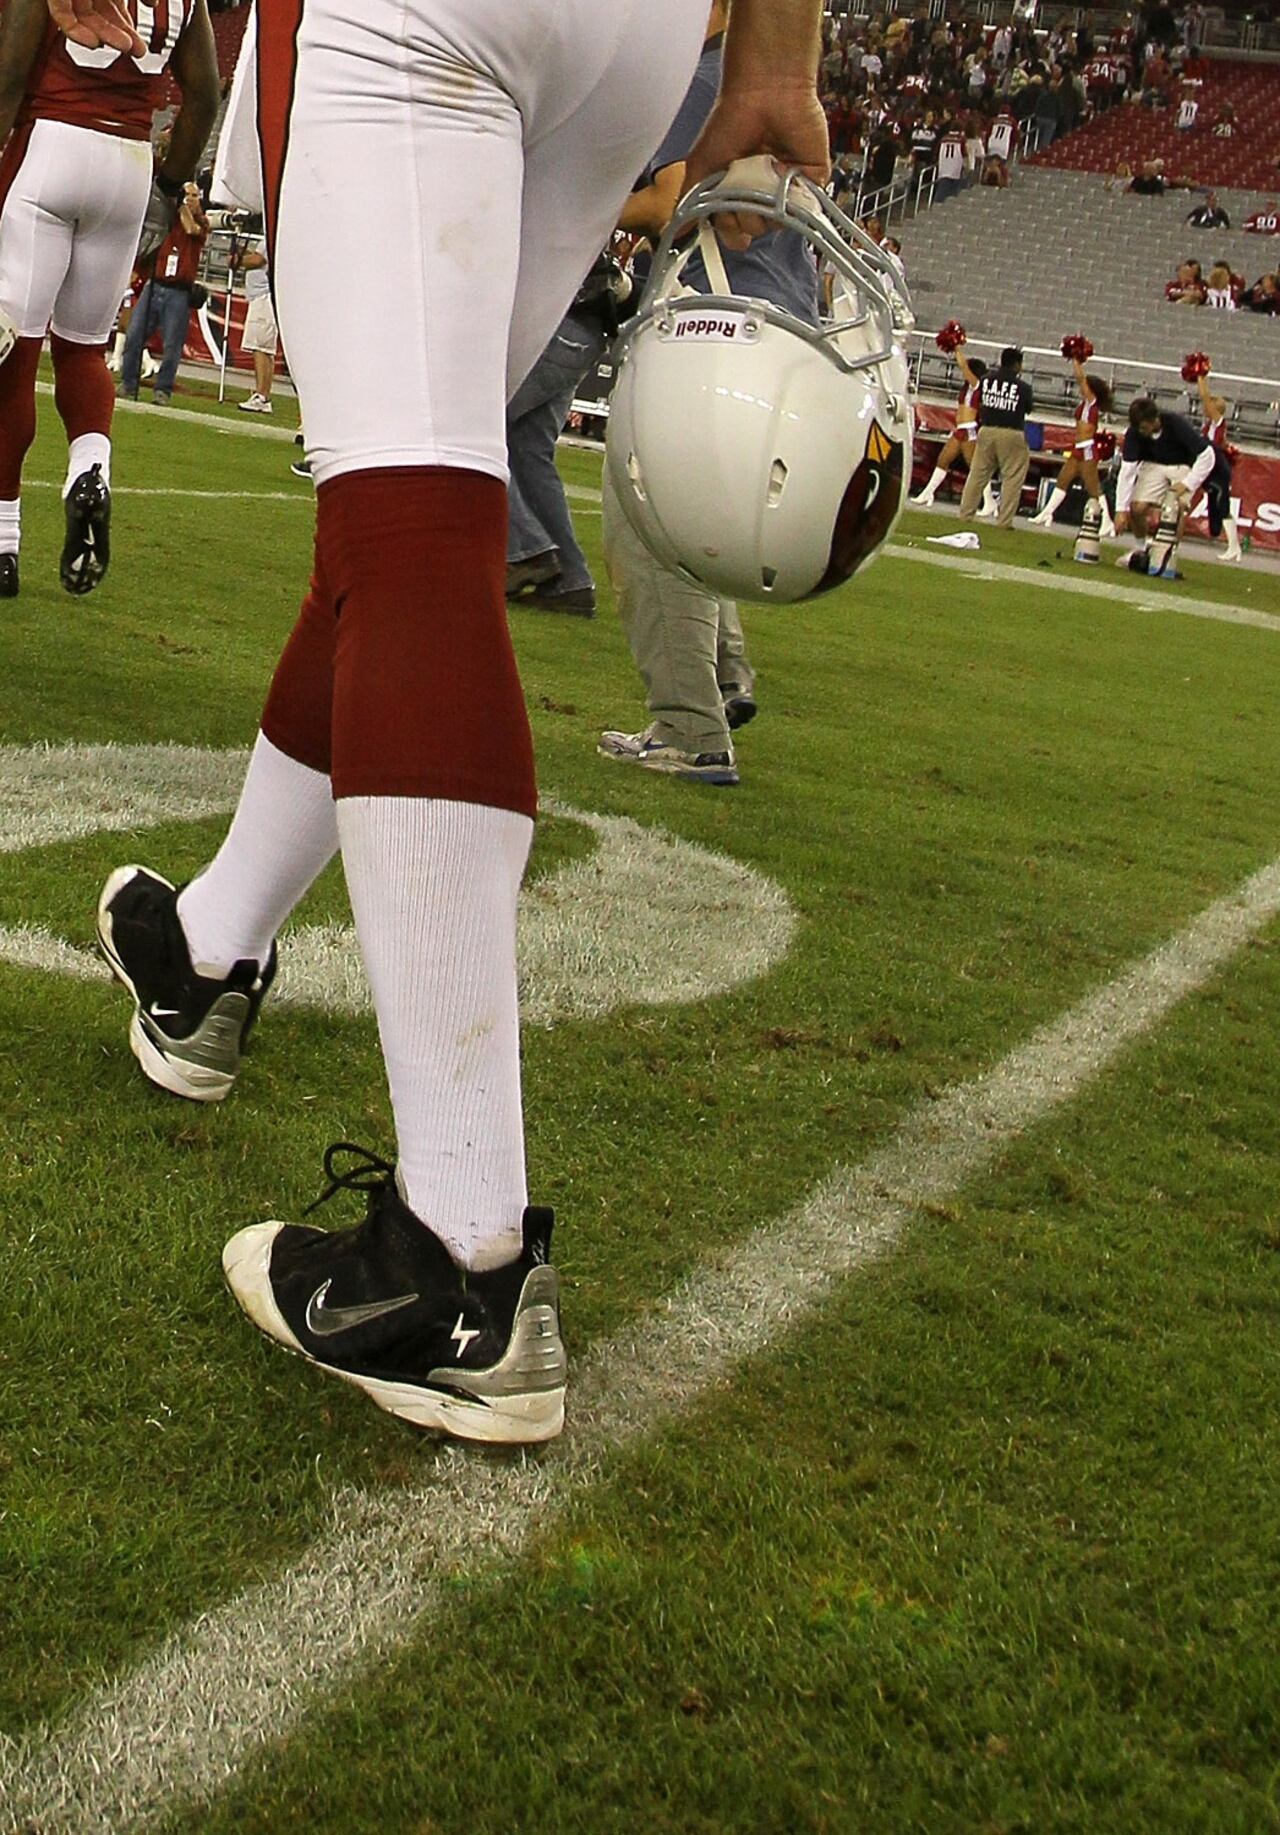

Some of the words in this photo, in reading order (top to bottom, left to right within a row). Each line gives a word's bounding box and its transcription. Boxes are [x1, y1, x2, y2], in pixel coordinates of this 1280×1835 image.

[1091, 63, 1109, 78] 34
[994, 125, 1006, 139] 11
[945, 144, 956, 158] 11
[675, 319, 737, 338] Riddell
